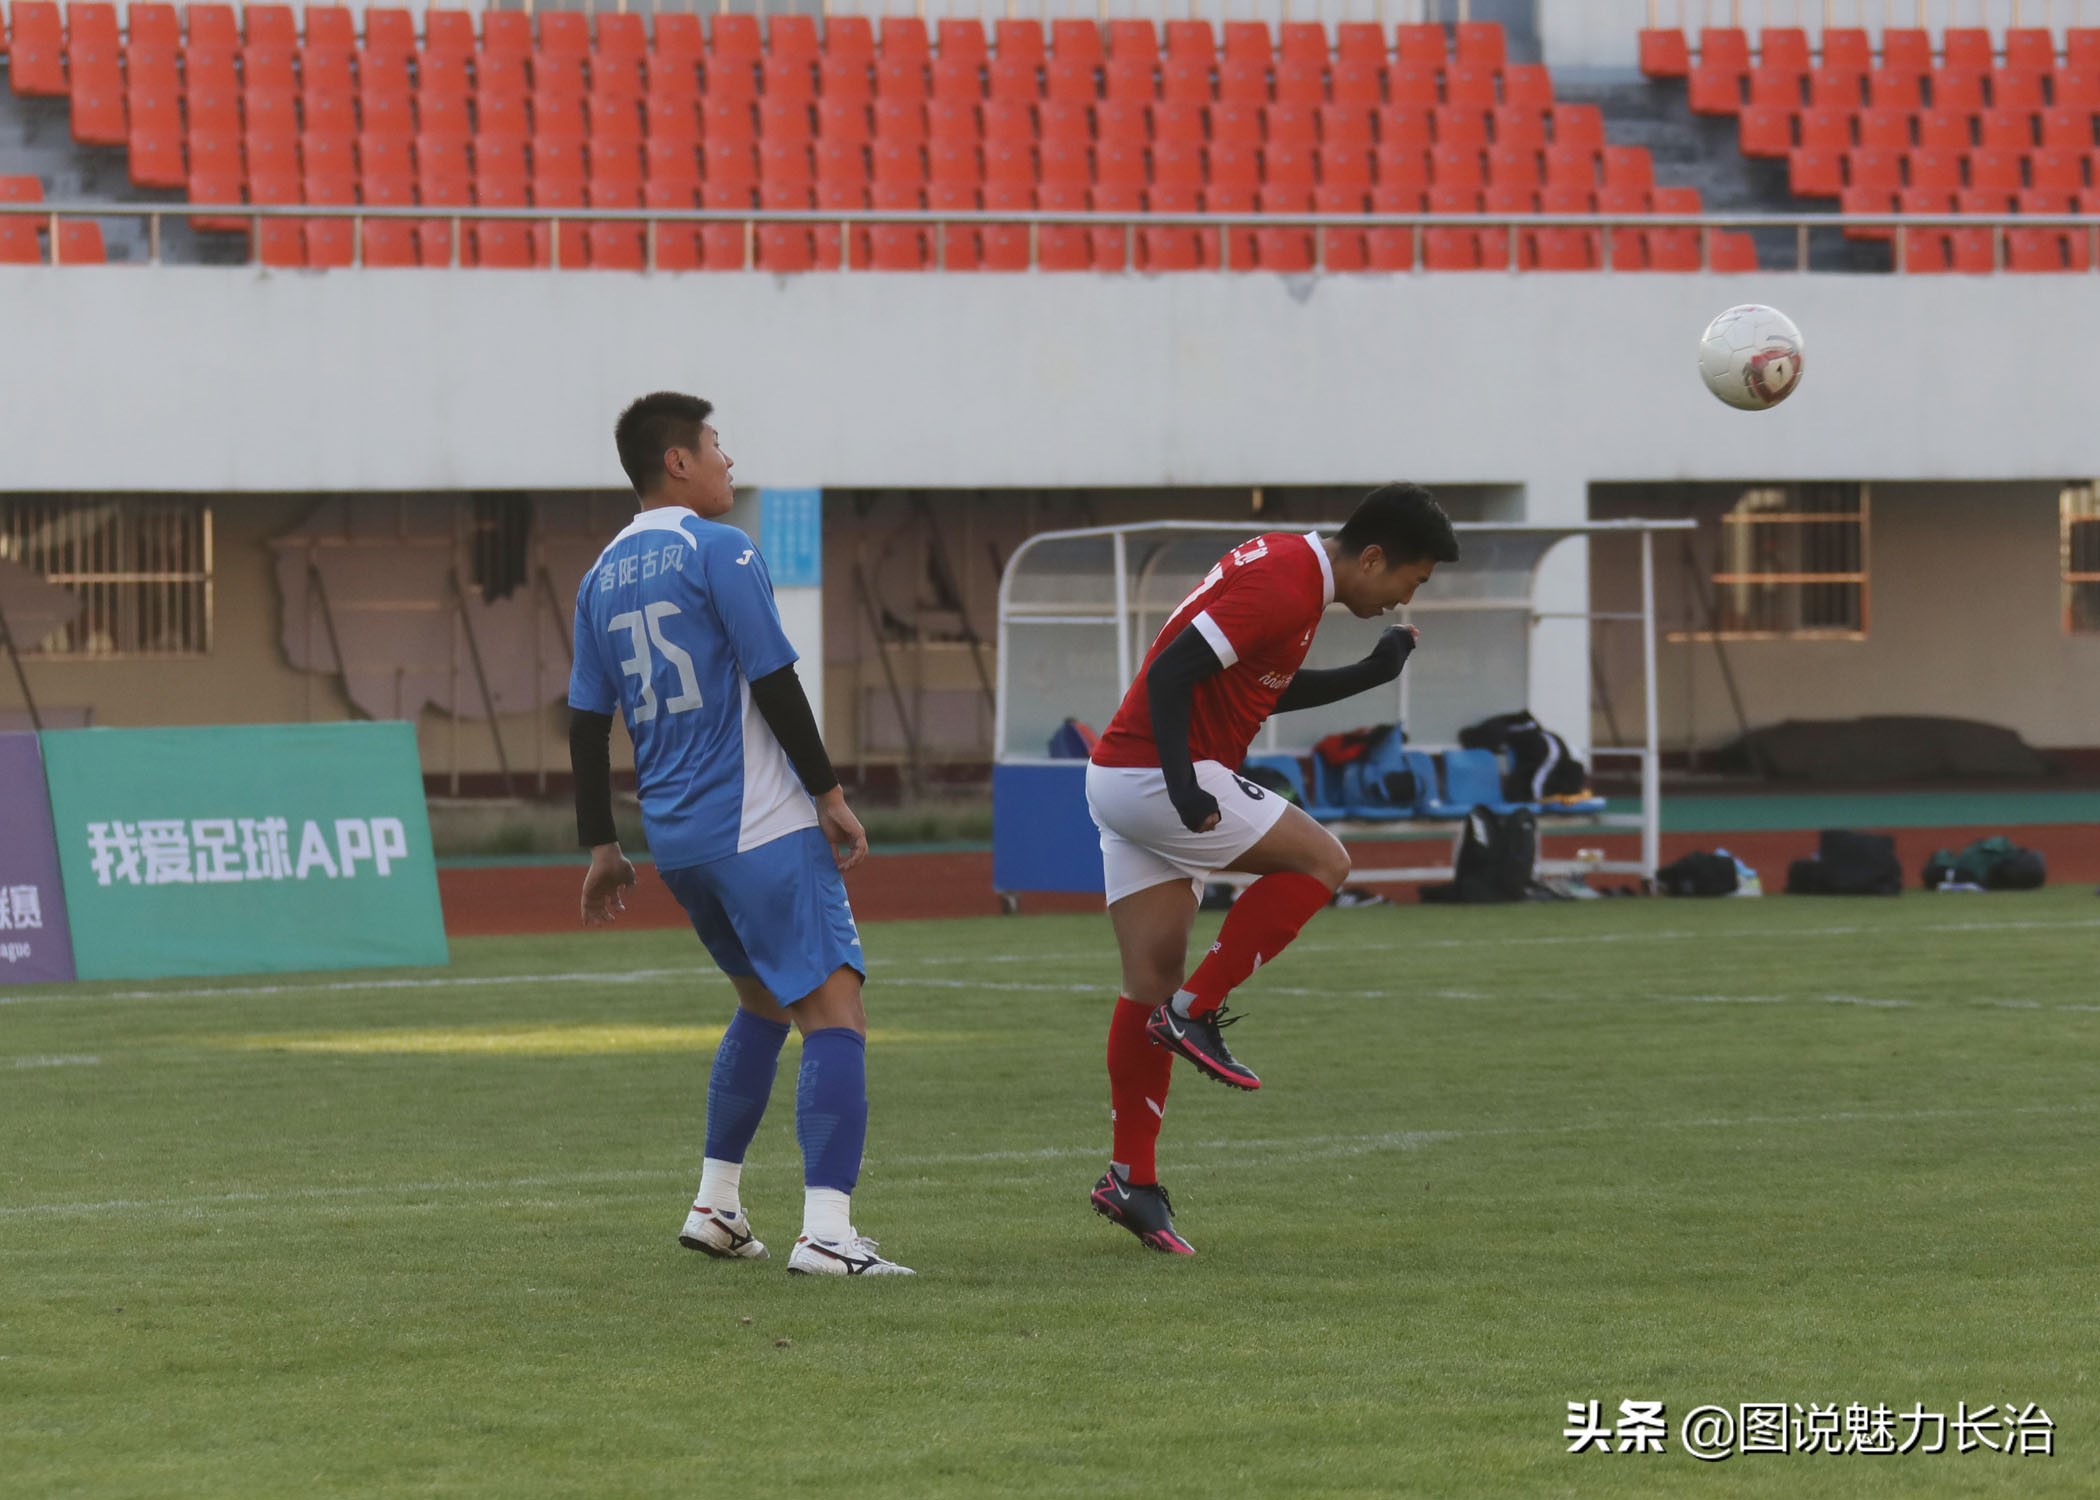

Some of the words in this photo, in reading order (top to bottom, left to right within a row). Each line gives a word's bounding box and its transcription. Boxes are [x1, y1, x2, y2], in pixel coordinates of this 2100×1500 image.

[607, 600, 703, 724] 35
[86, 816, 408, 886] 我爱足球APP
